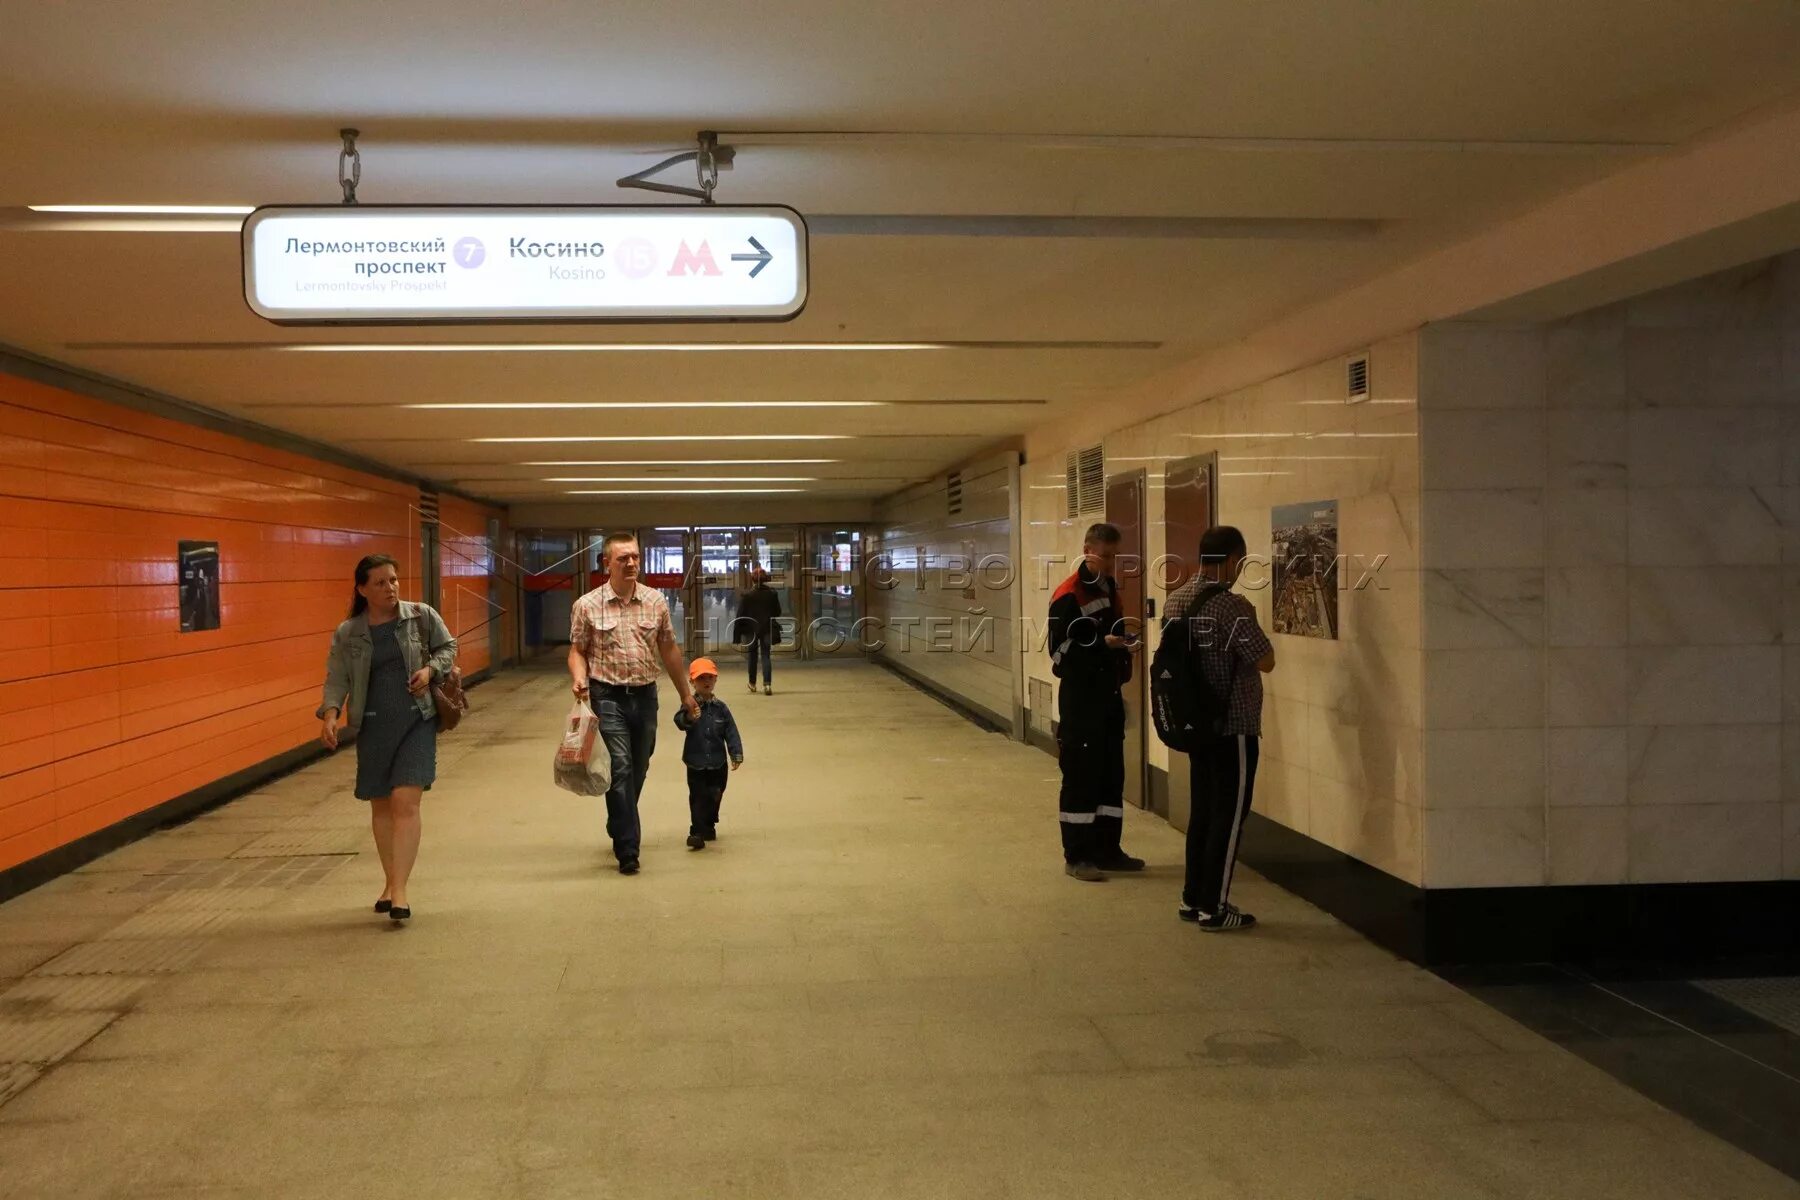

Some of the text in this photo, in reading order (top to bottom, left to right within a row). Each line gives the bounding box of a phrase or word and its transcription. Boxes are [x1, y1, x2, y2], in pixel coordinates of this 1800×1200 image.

[284, 237, 446, 257] Лермонтовский
[463, 243, 476, 262] 7
[509, 237, 605, 258] Косино
[624, 245, 651, 269] 15
[354, 260, 447, 278] проспект
[549, 265, 606, 280] Kosino
[295, 279, 448, 294] Lermontovsky Prospekt
